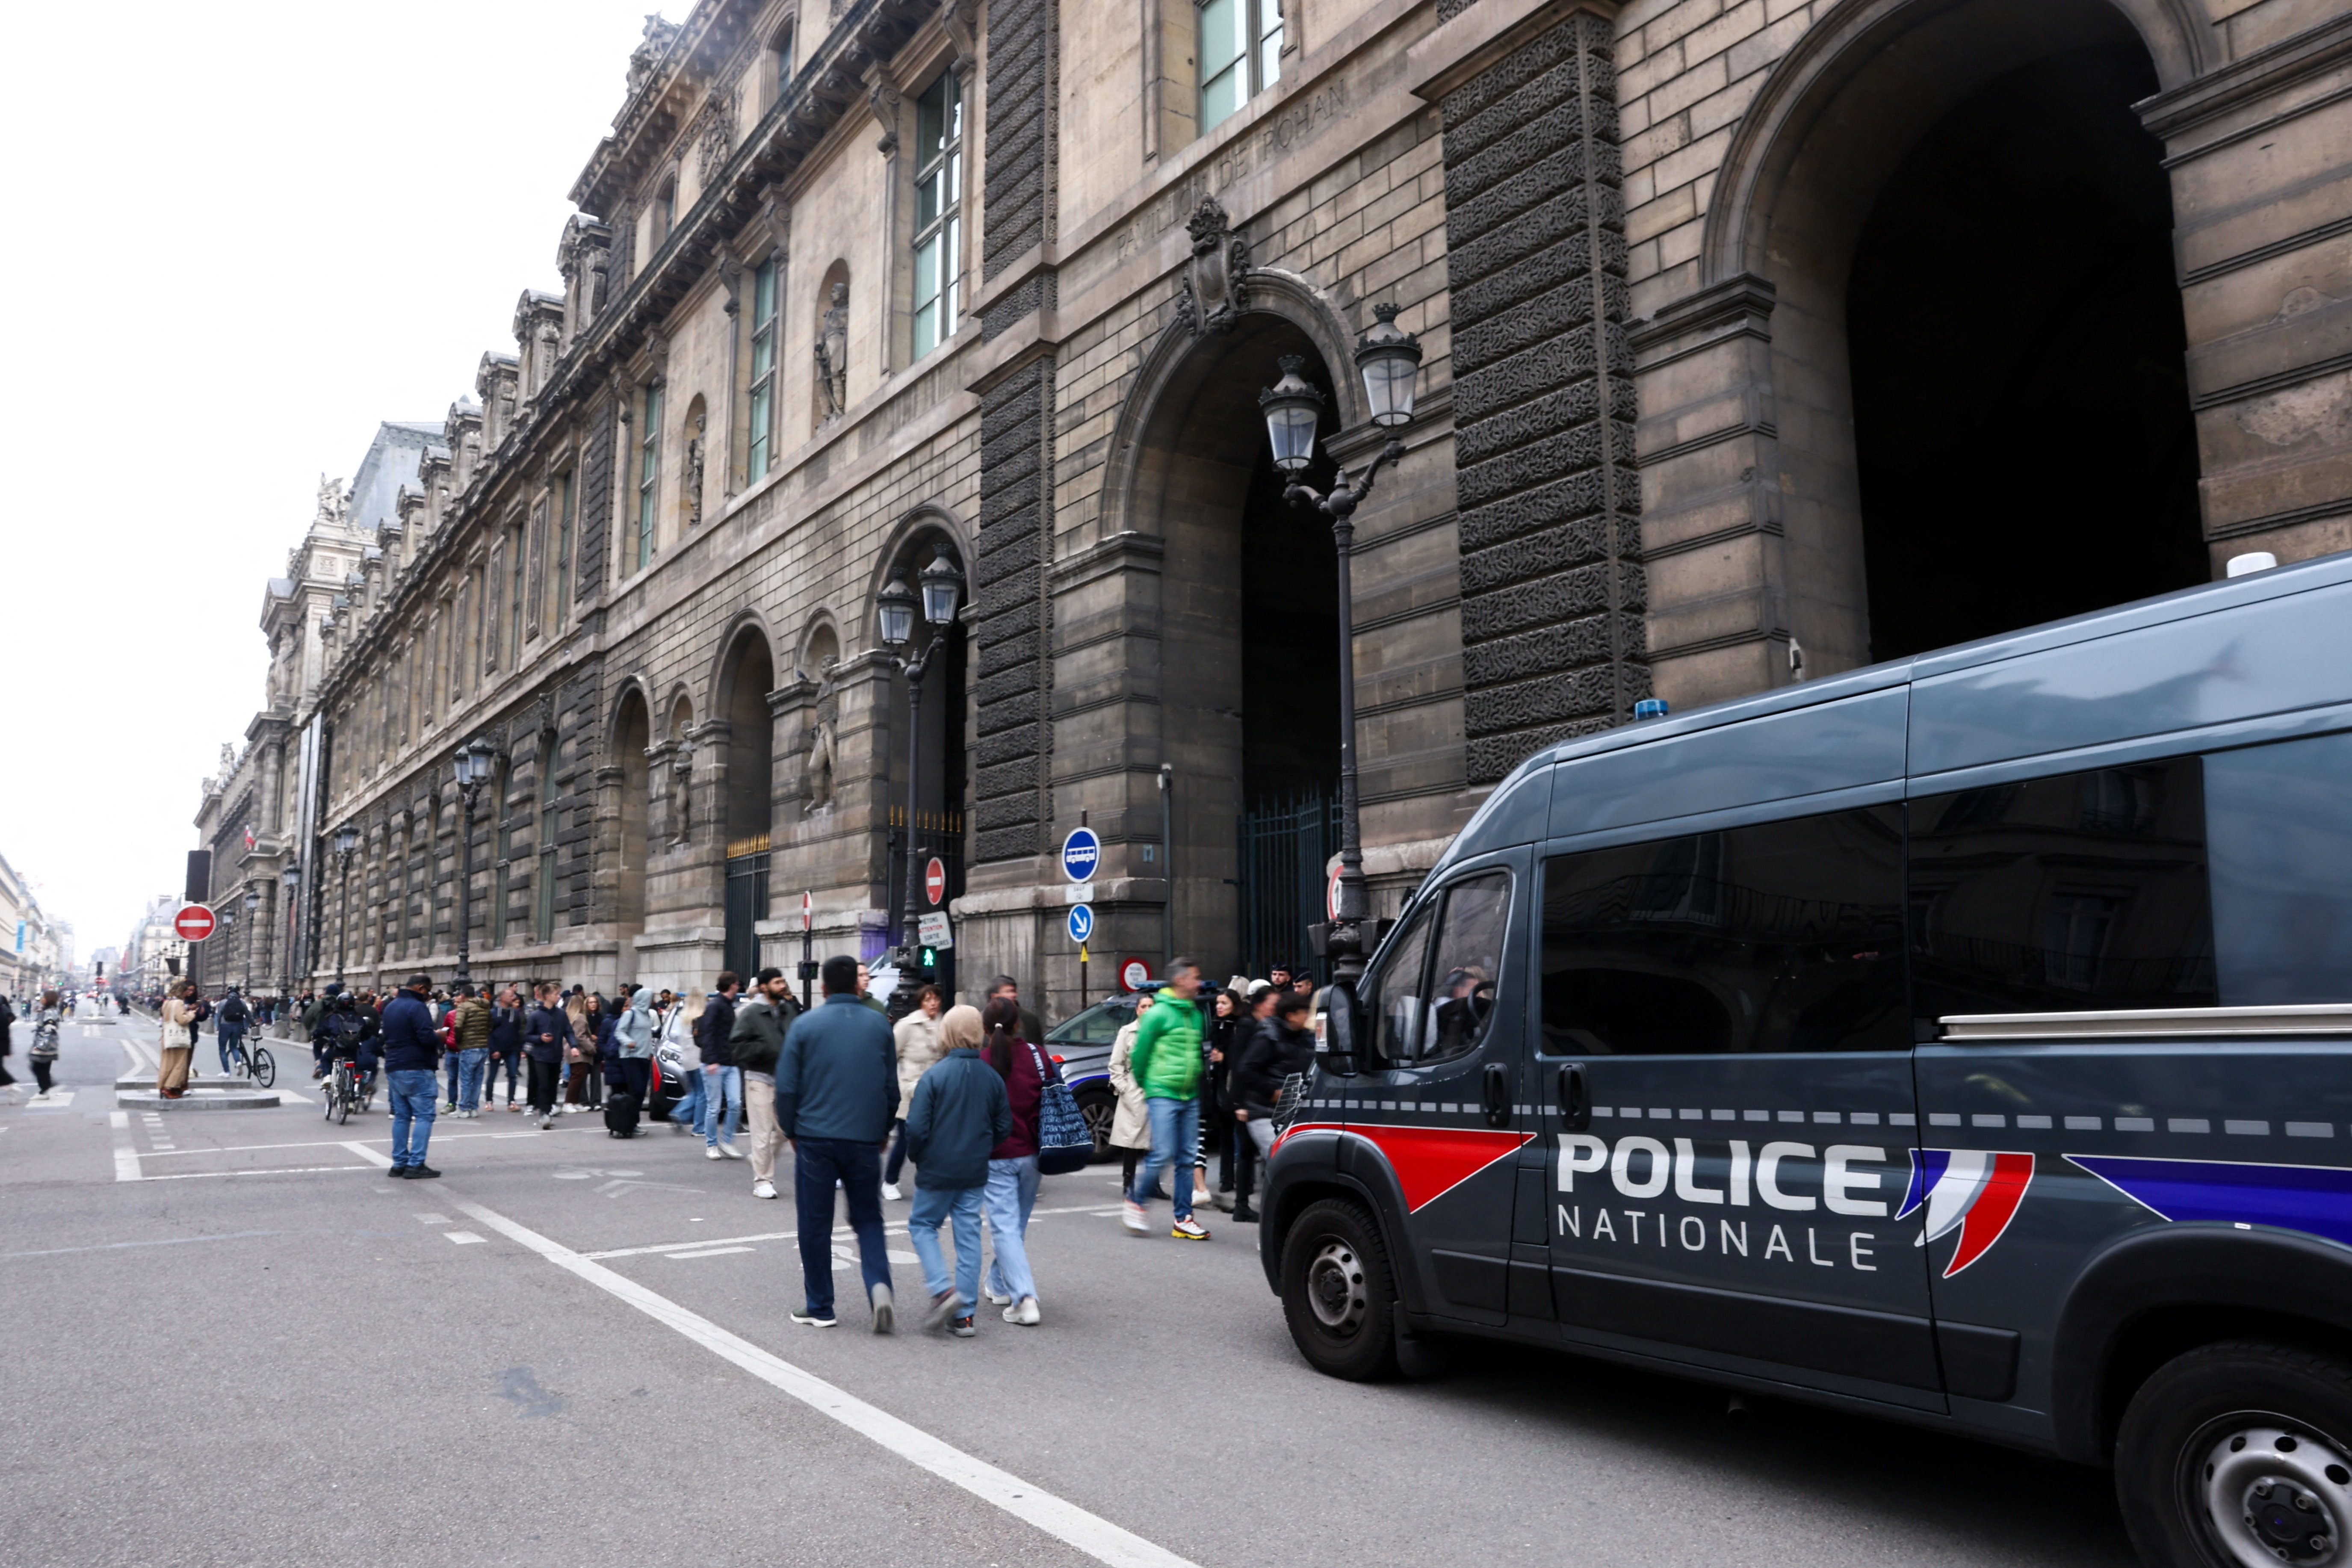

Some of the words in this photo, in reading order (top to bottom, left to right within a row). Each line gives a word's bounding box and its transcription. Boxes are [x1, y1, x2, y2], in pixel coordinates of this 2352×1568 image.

[1220, 147, 1248, 189] DE
[1557, 1133, 1888, 1217] POLICE
[1557, 1204, 1877, 1271] NATIONALE
